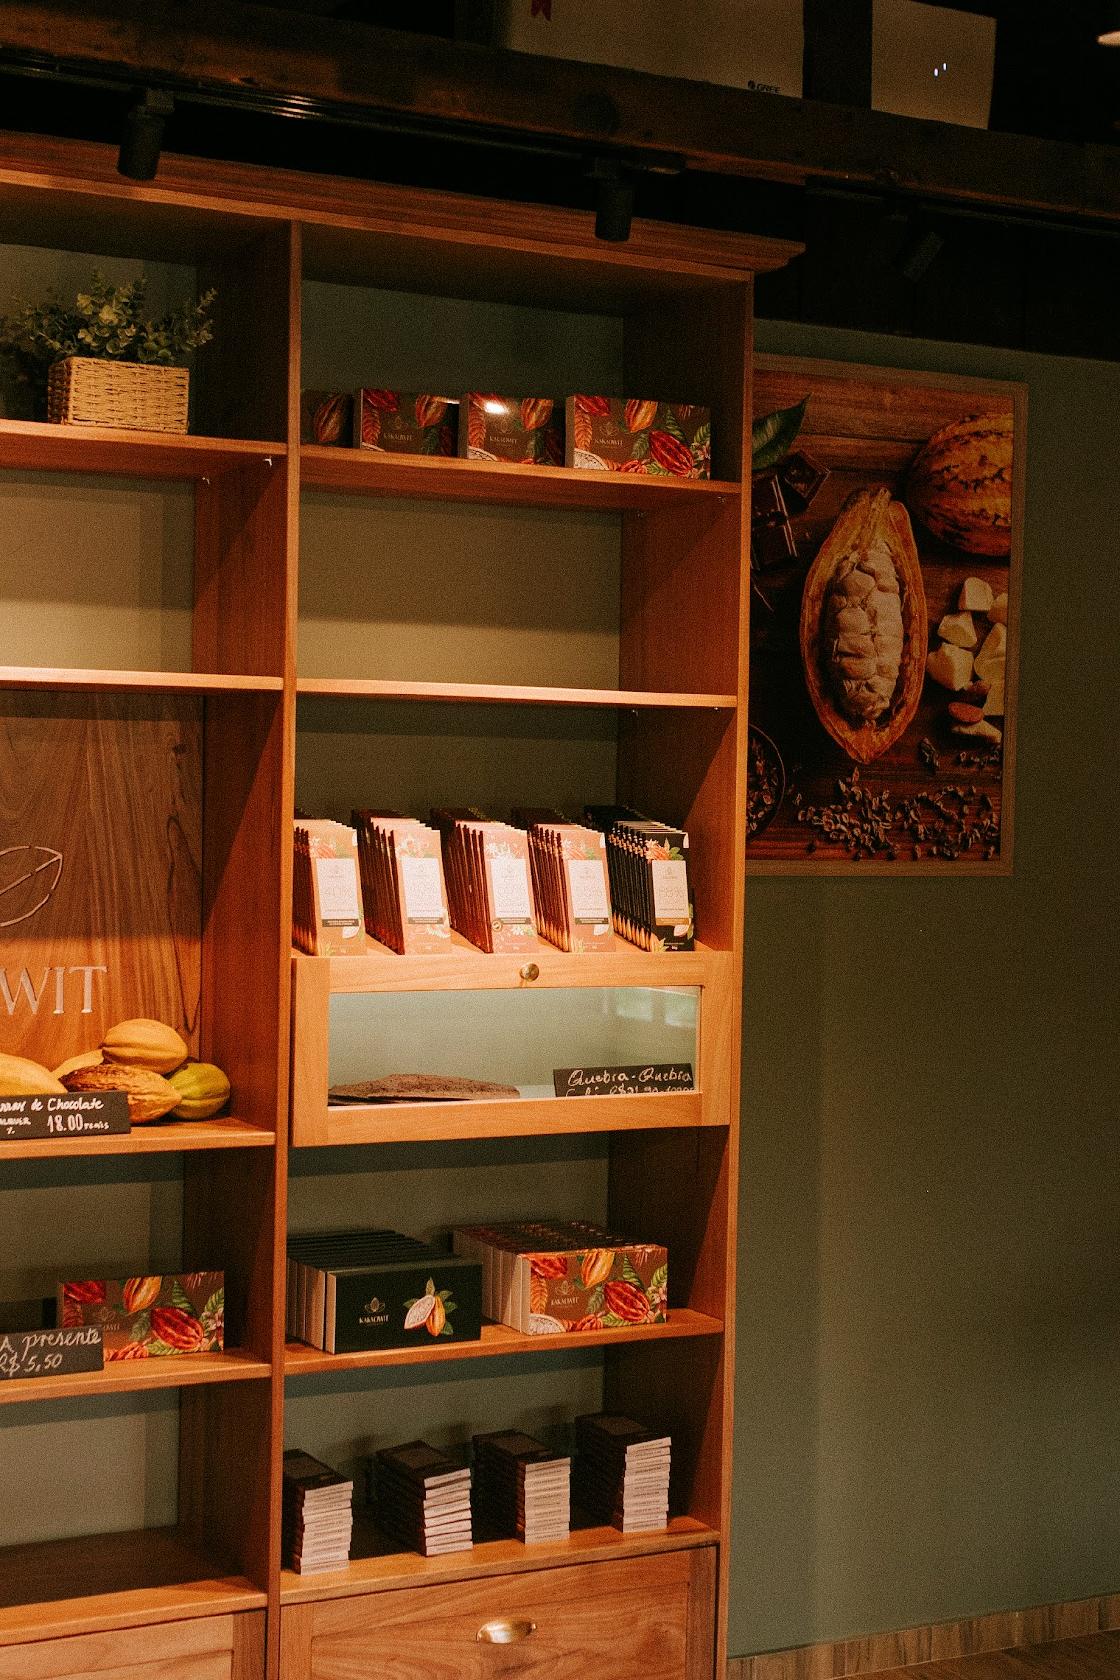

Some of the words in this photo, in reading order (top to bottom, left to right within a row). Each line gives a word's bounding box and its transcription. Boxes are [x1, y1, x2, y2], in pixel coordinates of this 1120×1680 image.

[0, 965, 108, 1016] WIT
[30, 1098, 44, 1112] de
[47, 1096, 105, 1112] Chocolate
[22, 1327, 102, 1362] presente
